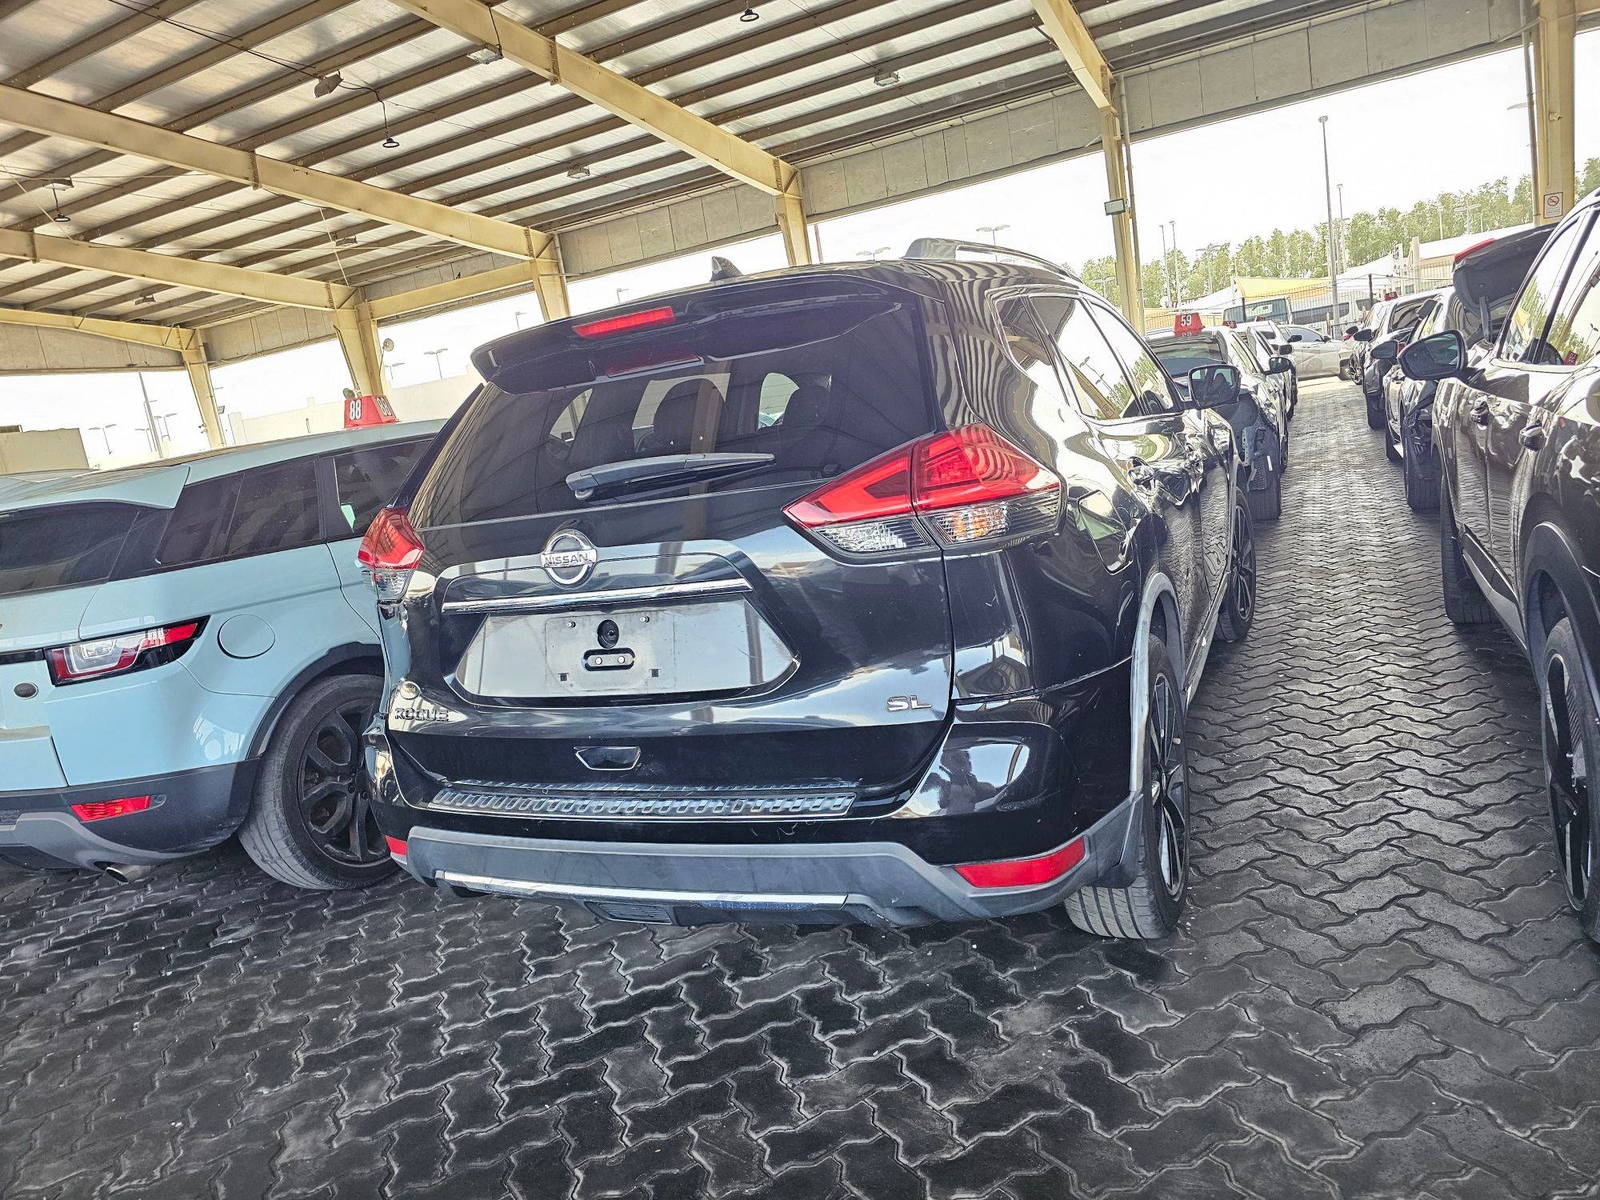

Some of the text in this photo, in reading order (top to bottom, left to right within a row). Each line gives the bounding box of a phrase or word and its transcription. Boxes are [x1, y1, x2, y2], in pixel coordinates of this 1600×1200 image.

[1180, 314, 1192, 327] 59
[349, 399, 362, 420] 88
[543, 552, 590, 566] NISSAN
[887, 695, 933, 711] SL
[394, 707, 450, 722] ROGUE
